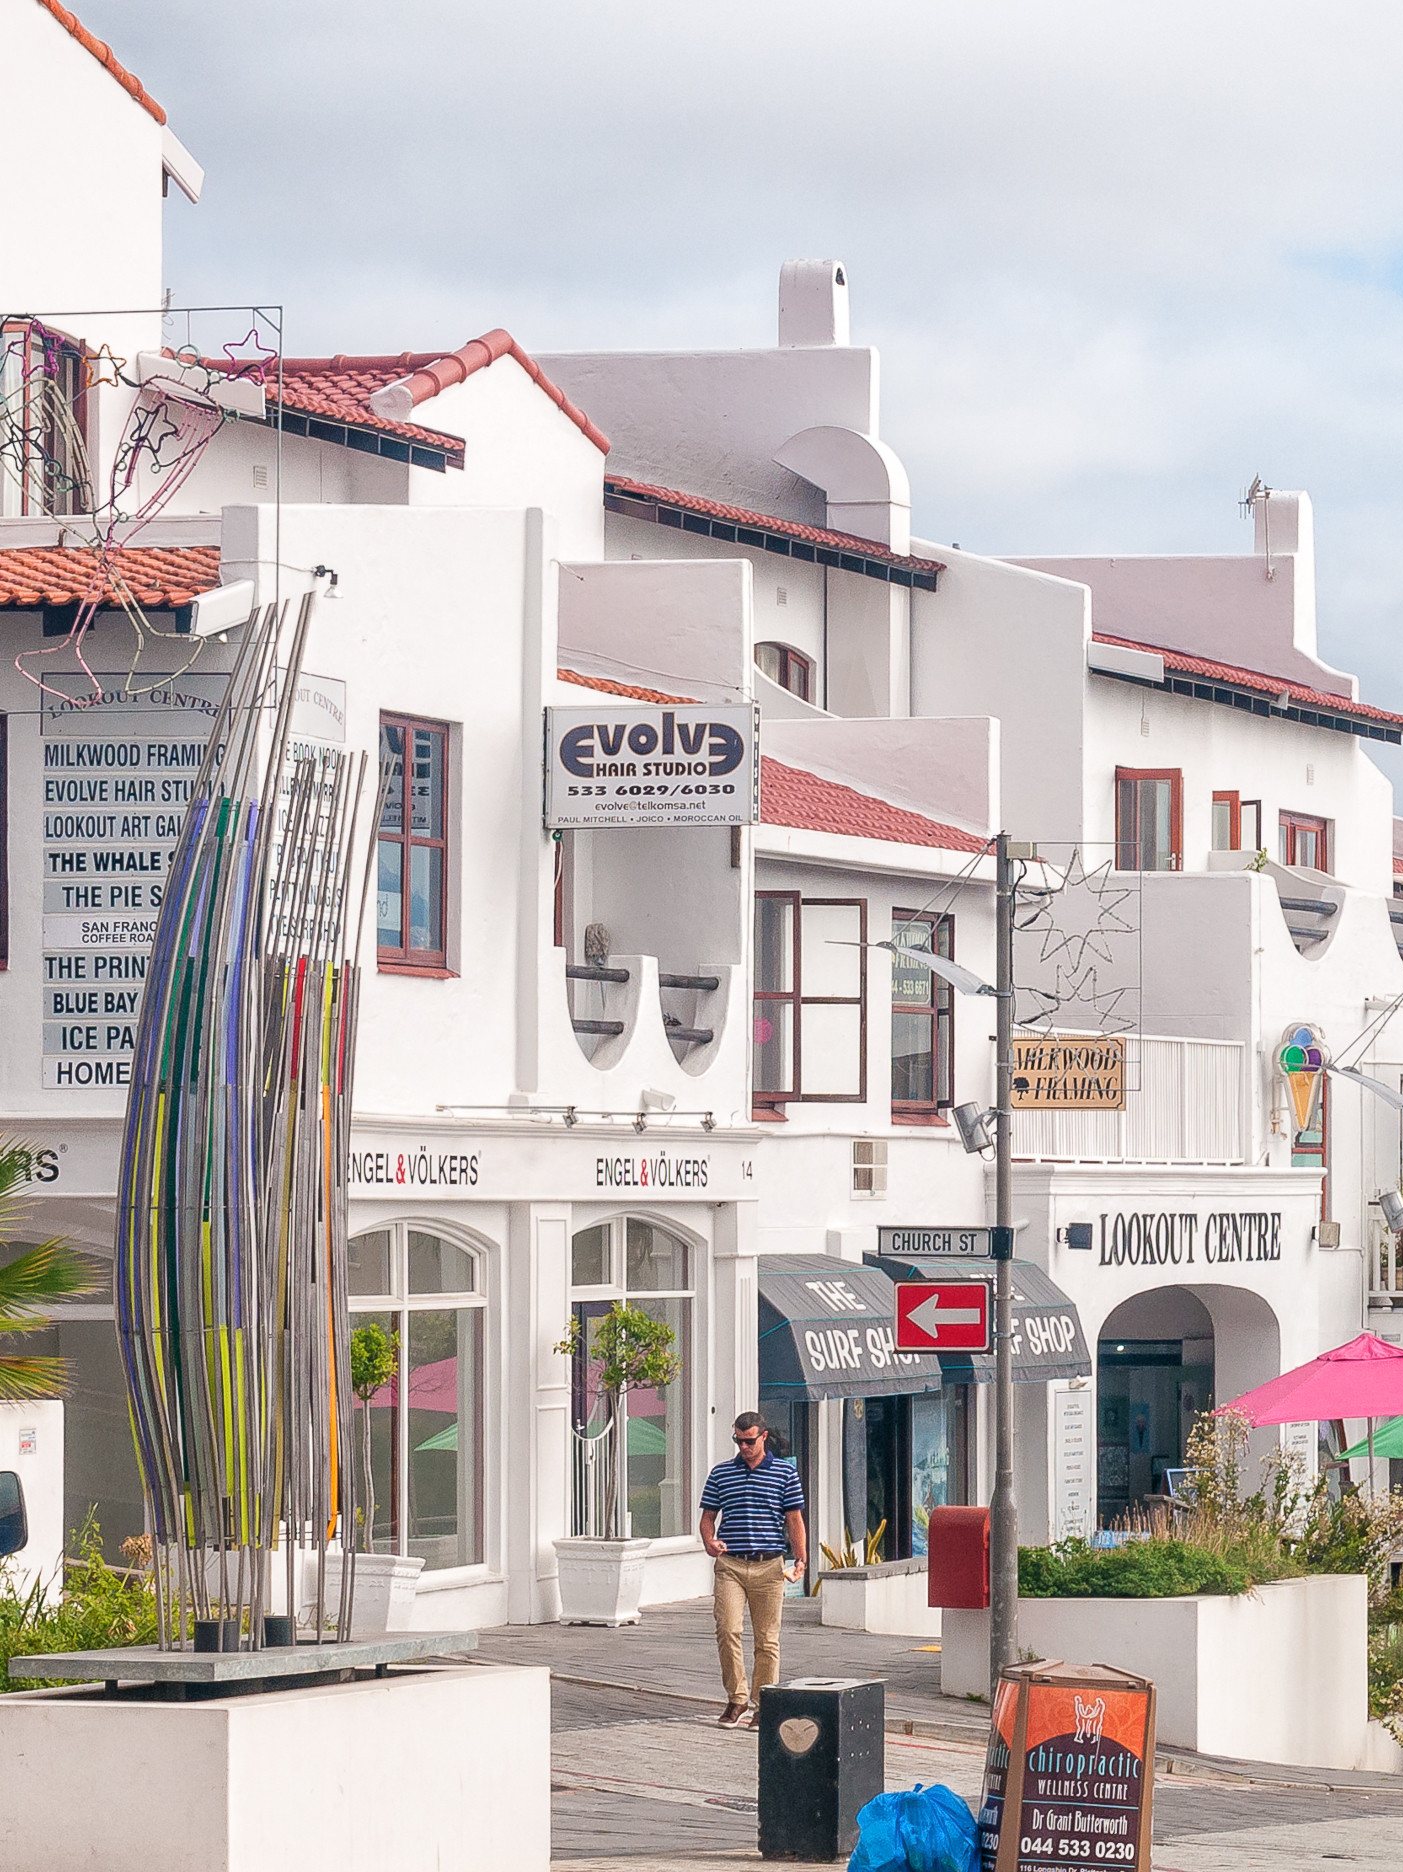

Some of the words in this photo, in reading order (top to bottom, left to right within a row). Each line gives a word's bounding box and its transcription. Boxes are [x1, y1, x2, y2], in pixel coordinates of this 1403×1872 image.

[44, 744, 140, 766] MILKWOOD
[596, 762, 637, 777] HAIR
[643, 762, 707, 777] STUDIO
[45, 780, 108, 801] EVOLVE
[114, 780, 155, 801] HAIR
[568, 785, 607, 796] 533
[615, 784, 735, 796] 6029/6030
[595, 800, 706, 811] evolve@telkomsa.net
[45, 815, 116, 838] LOOKOUT
[121, 815, 151, 838] ART
[673, 814, 726, 822] MOROCCAN
[729, 814, 743, 822] OIL
[48, 852, 87, 872] THE
[94, 852, 162, 871] WHALE
[62, 886, 102, 907] THE
[111, 886, 142, 907] PIE
[82, 922, 109, 933] SAN
[82, 933, 126, 943] COFFEE
[44, 957, 86, 979] THE
[53, 992, 98, 1013] BLUE
[104, 992, 138, 1013] BAY
[62, 1026, 98, 1050] ICE
[57, 1062, 130, 1085] HOME
[1034, 1077, 1118, 1100] FRAMING
[741, 1160, 753, 1180] 14
[892, 1232, 951, 1252] CHURCH
[959, 1232, 978, 1252] ST
[1099, 1213, 1198, 1266] LOOKOUT
[1205, 1213, 1281, 1264] CENTRE
[805, 1281, 866, 1312] THE
[1025, 1316, 1076, 1355] SHOP
[805, 1330, 863, 1371] SURF
[1029, 1745, 1139, 1779] chiropractic
[1038, 1779, 1089, 1797] WELLNESS
[1093, 1782, 1128, 1800] CENTRE
[1032, 1809, 1044, 1830] Dr
[1046, 1810, 1072, 1831] Grant
[1074, 1811, 1128, 1835] Butterworth
[1021, 1837, 1053, 1855] 044
[1058, 1839, 1090, 1857] 533
[1095, 1842, 1135, 1860] 0230
